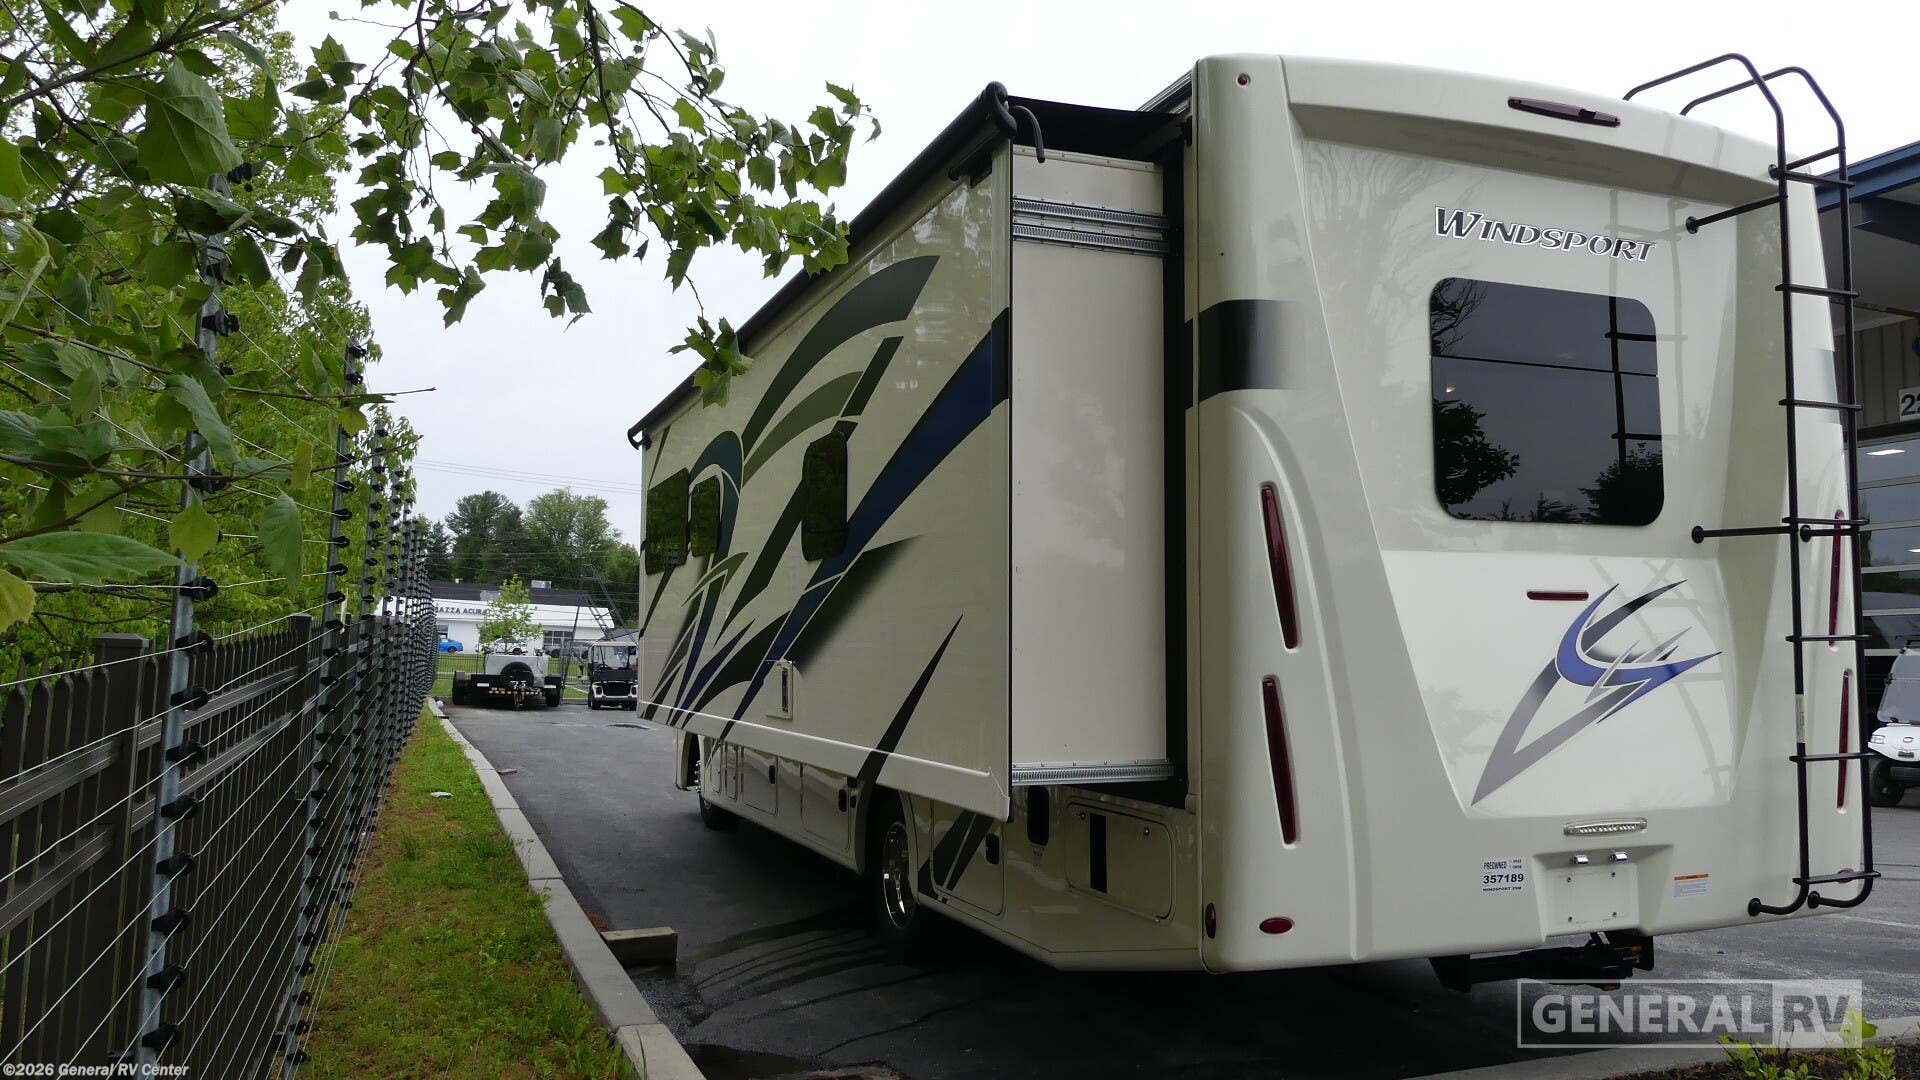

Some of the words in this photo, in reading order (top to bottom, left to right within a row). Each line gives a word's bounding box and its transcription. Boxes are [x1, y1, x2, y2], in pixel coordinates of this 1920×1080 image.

[1435, 206, 1655, 261] WINDSPORT
[1900, 393, 1920, 417] 2
[1483, 873, 1524, 884] 357189
